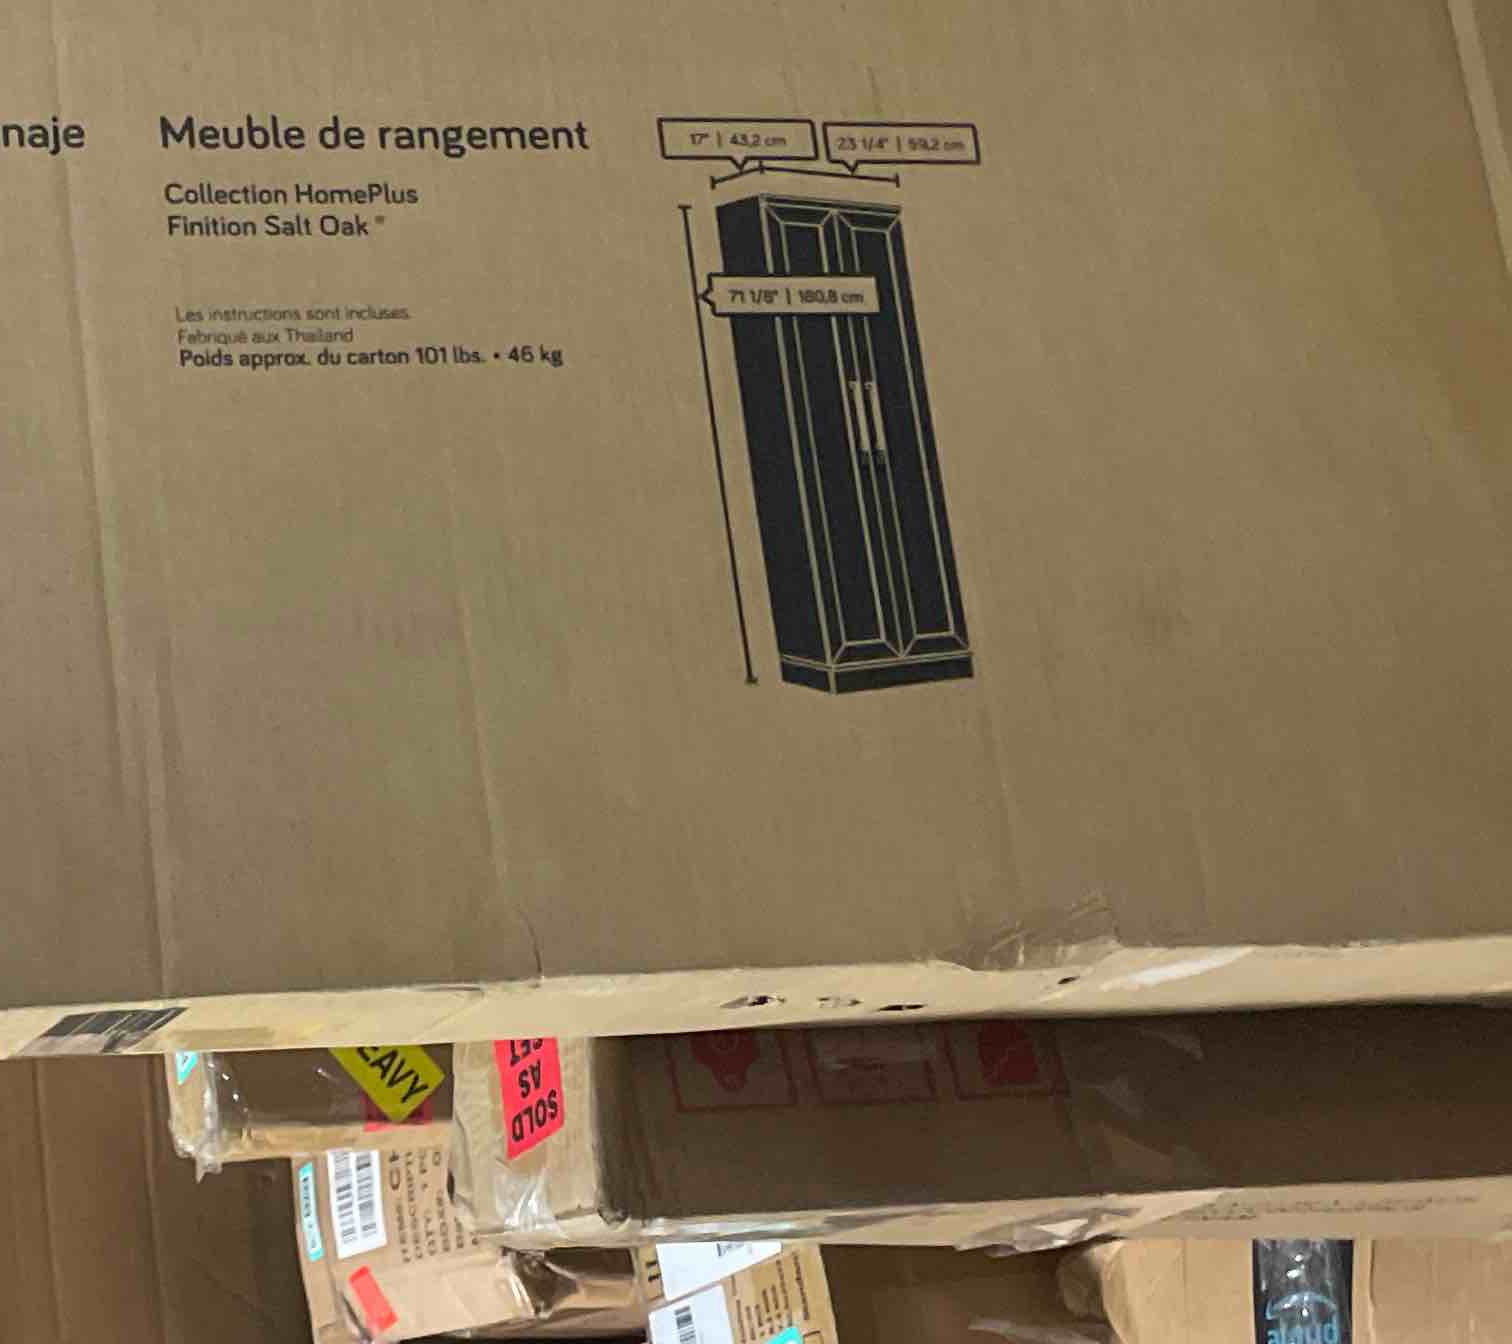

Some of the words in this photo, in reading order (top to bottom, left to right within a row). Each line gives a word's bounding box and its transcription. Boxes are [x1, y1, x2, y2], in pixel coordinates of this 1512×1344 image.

[159, 113, 306, 150] Meuble
[318, 115, 365, 150] de
[378, 121, 590, 159] rangement
[765, 137, 787, 147] cm
[164, 182, 288, 205] Collection
[294, 182, 419, 205] HomePlus
[167, 215, 257, 237] Finition
[264, 214, 313, 237] Salt
[842, 291, 864, 303] cm
[175, 306, 205, 323] Les
[208, 308, 302, 323] instructions
[305, 306, 341, 321] sont
[251, 331, 281, 345] aux
[284, 327, 354, 344] Thailand
[179, 347, 234, 368] Poids
[238, 352, 312, 371] approx.
[316, 347, 342, 366] du
[346, 348, 410, 366] carton
[415, 346, 448, 365] 101
[452, 345, 487, 364] lbs.
[539, 343, 564, 369] kg
[518, 1060, 541, 1099] AS
[512, 1089, 558, 1142] SOLD
